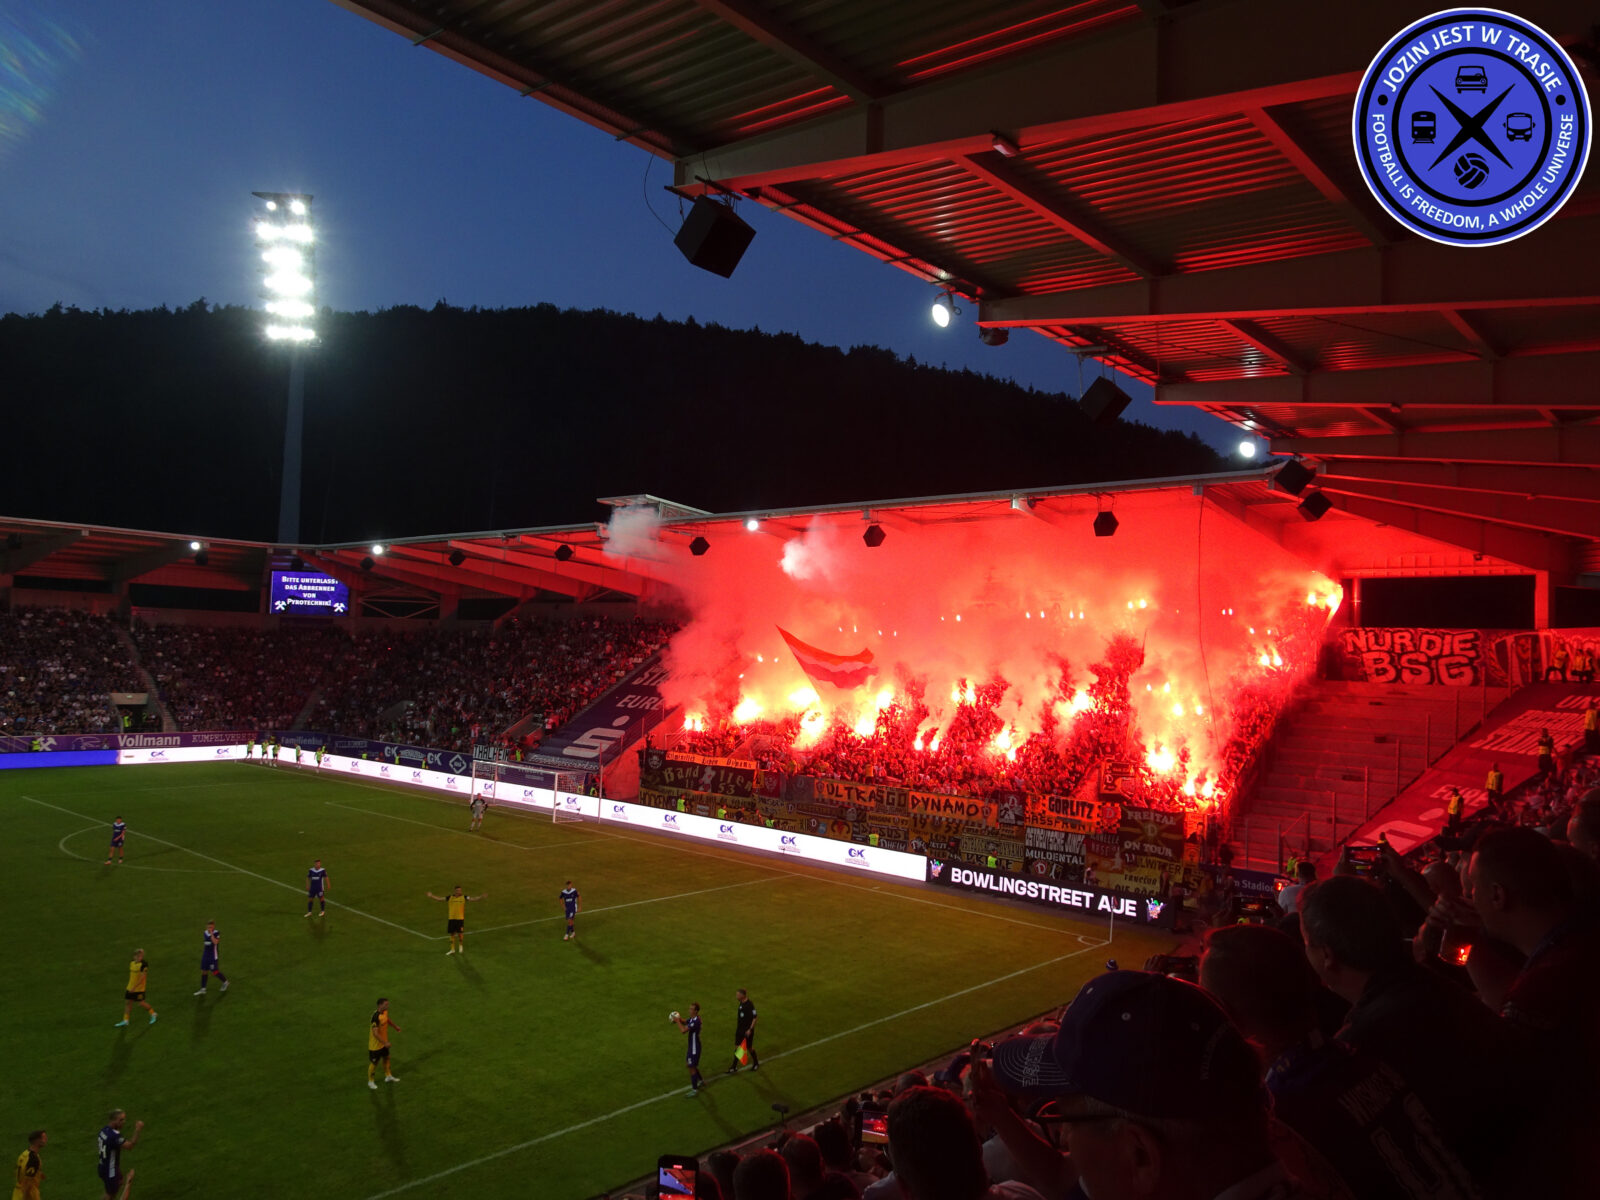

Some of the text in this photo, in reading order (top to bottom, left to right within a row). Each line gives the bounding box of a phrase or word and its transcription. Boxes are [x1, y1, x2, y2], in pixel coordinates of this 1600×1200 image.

[300, 577, 338, 585] UNTERLASS
[1344, 630, 1478, 658] NUR DIE
[1361, 652, 1475, 686] BSG
[117, 734, 181, 748] Vollmann
[910, 794, 979, 817] DYNAMO
[1126, 810, 1176, 826] FREITAL
[1025, 848, 1085, 865] MULDENTAL
[1123, 840, 1141, 851] ON
[1143, 843, 1173, 857] TOUR
[951, 867, 1137, 917] BOWLINGSTREET AUE
